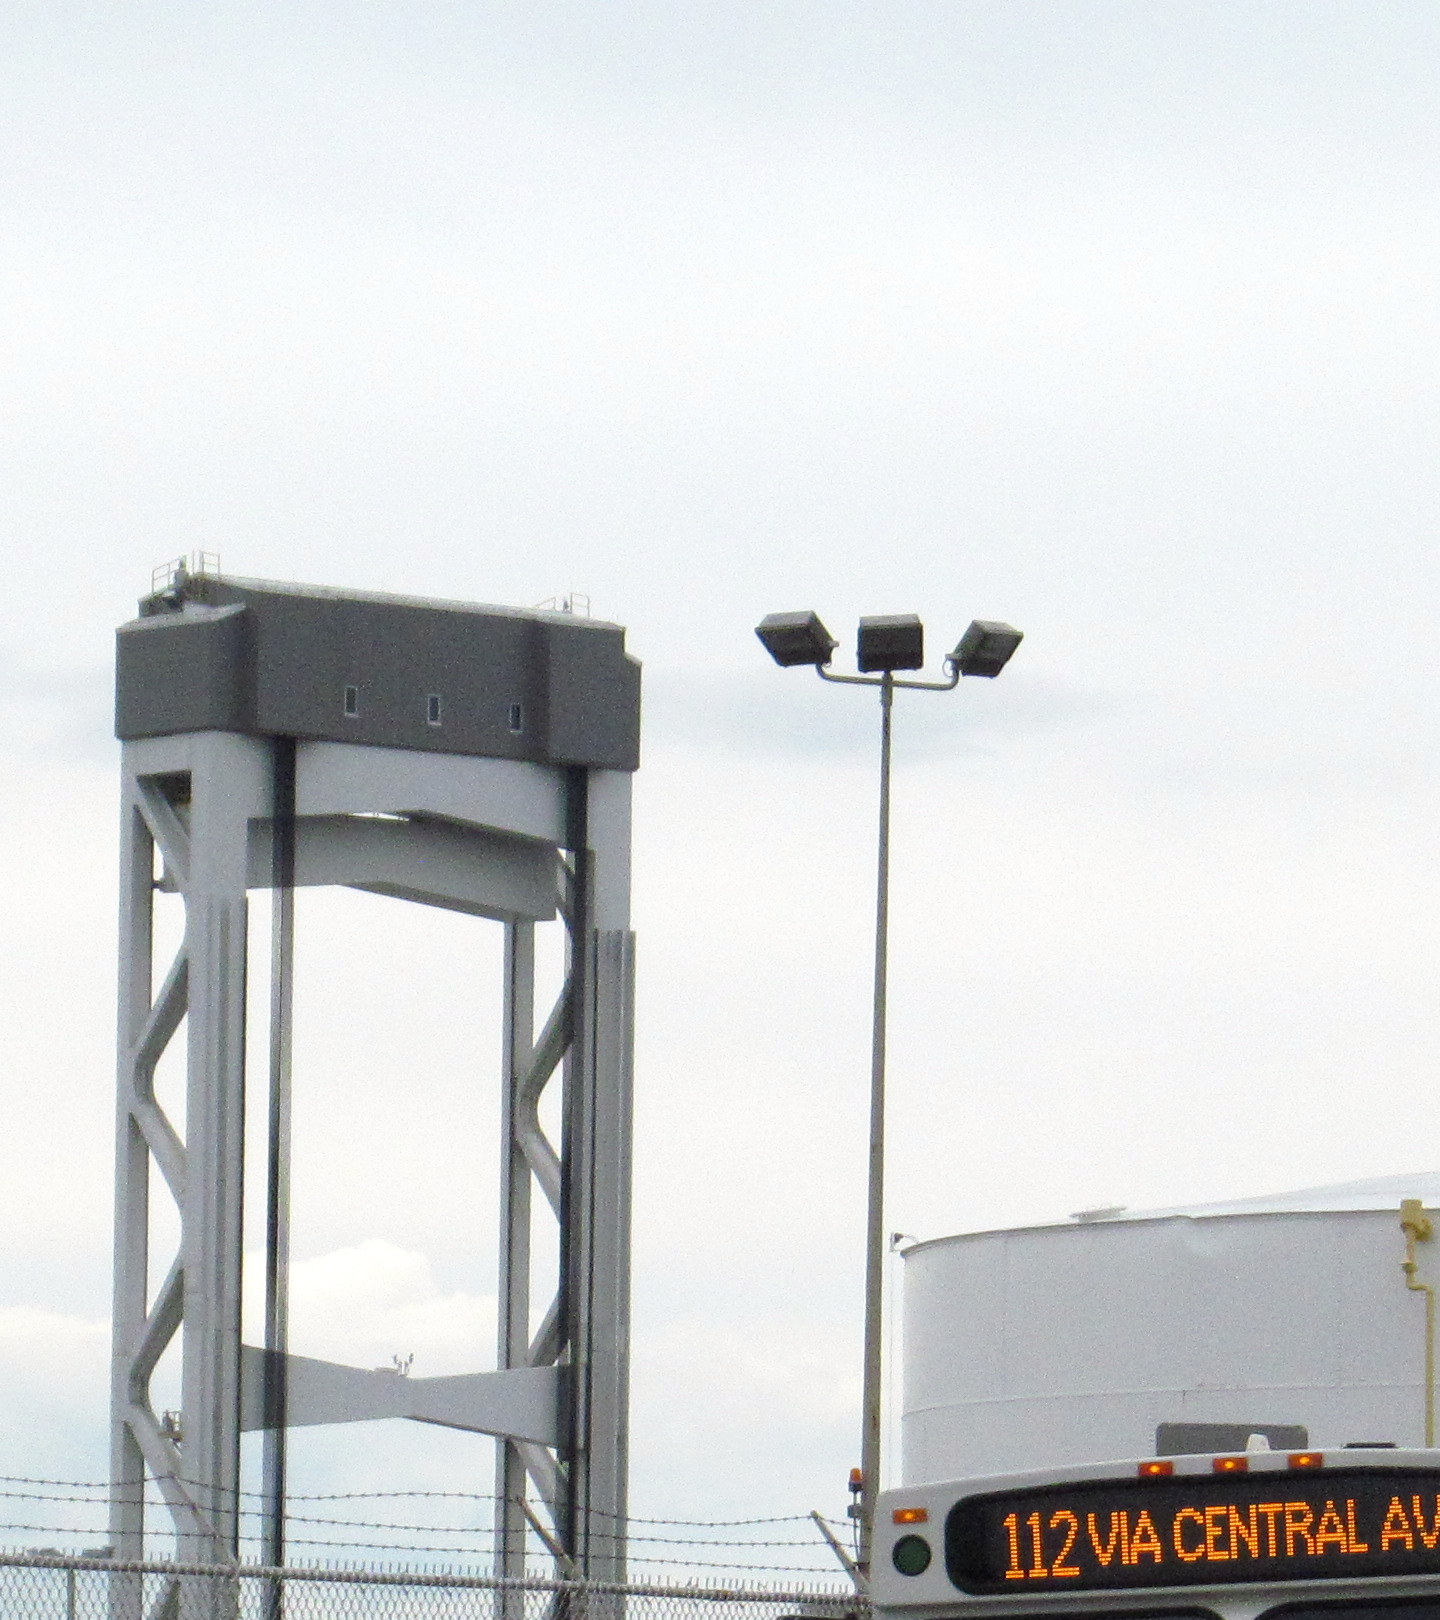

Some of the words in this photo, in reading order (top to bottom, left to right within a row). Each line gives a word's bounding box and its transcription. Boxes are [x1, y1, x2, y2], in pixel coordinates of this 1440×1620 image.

[1002, 1510, 1080, 1579] 112
[1086, 1508, 1162, 1566] VIA
[1171, 1498, 1368, 1562] CENTRAL
